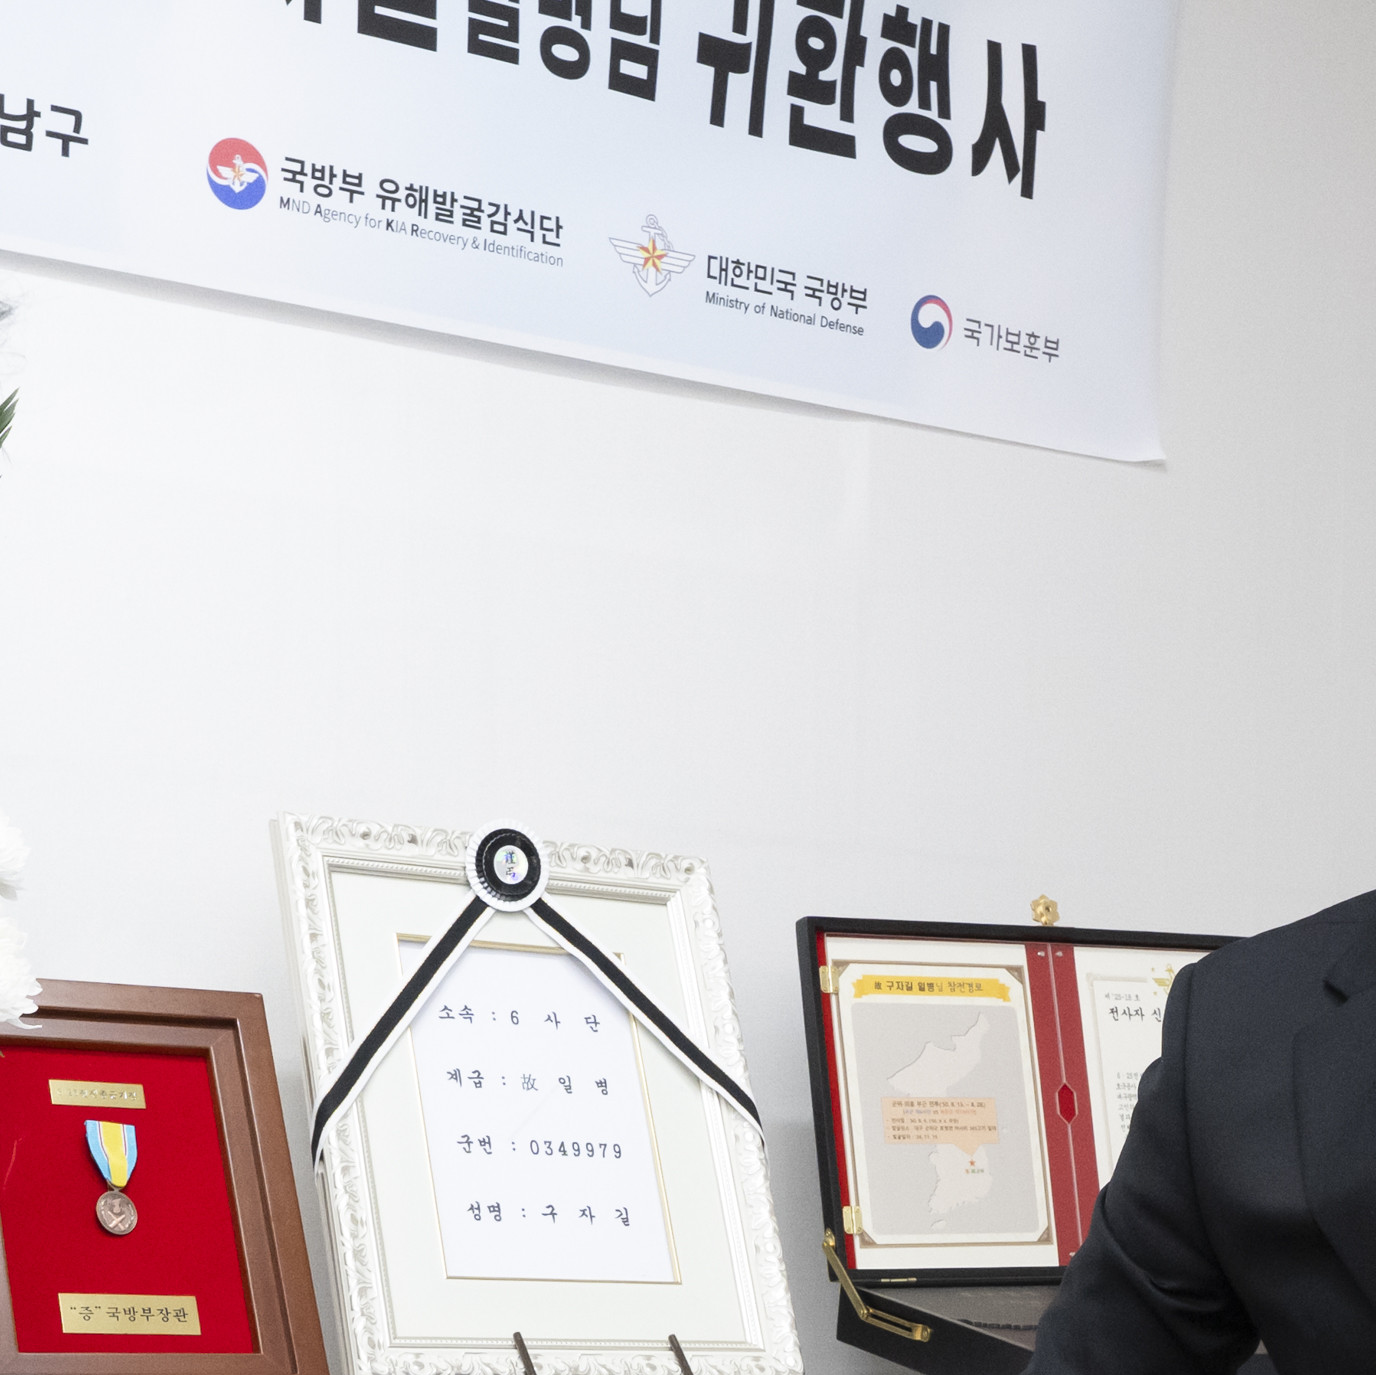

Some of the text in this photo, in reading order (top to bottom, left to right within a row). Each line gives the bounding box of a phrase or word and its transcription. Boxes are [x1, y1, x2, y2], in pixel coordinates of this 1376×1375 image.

[696, 0, 1046, 200] 귀환행사
[281, 156, 563, 247] 국방부 유해발굴감식단
[279, 196, 564, 268] MND Agency for KIA Recovery & Identification
[707, 255, 869, 314] 대한민국 국방부
[706, 291, 865, 337] Ministry of National Defense
[963, 318, 1060, 363] 국가보훈부
[886, 981, 913, 991] 구자길
[439, 1005, 474, 1023] 소속
[1109, 1006, 1144, 1022] 전사자
[447, 1068, 484, 1089] 계급
[457, 1134, 492, 1155] 군번
[529, 1139, 622, 1159] 0349979
[467, 1200, 502, 1222] 성명
[106, 1306, 189, 1323] 국방부장관
